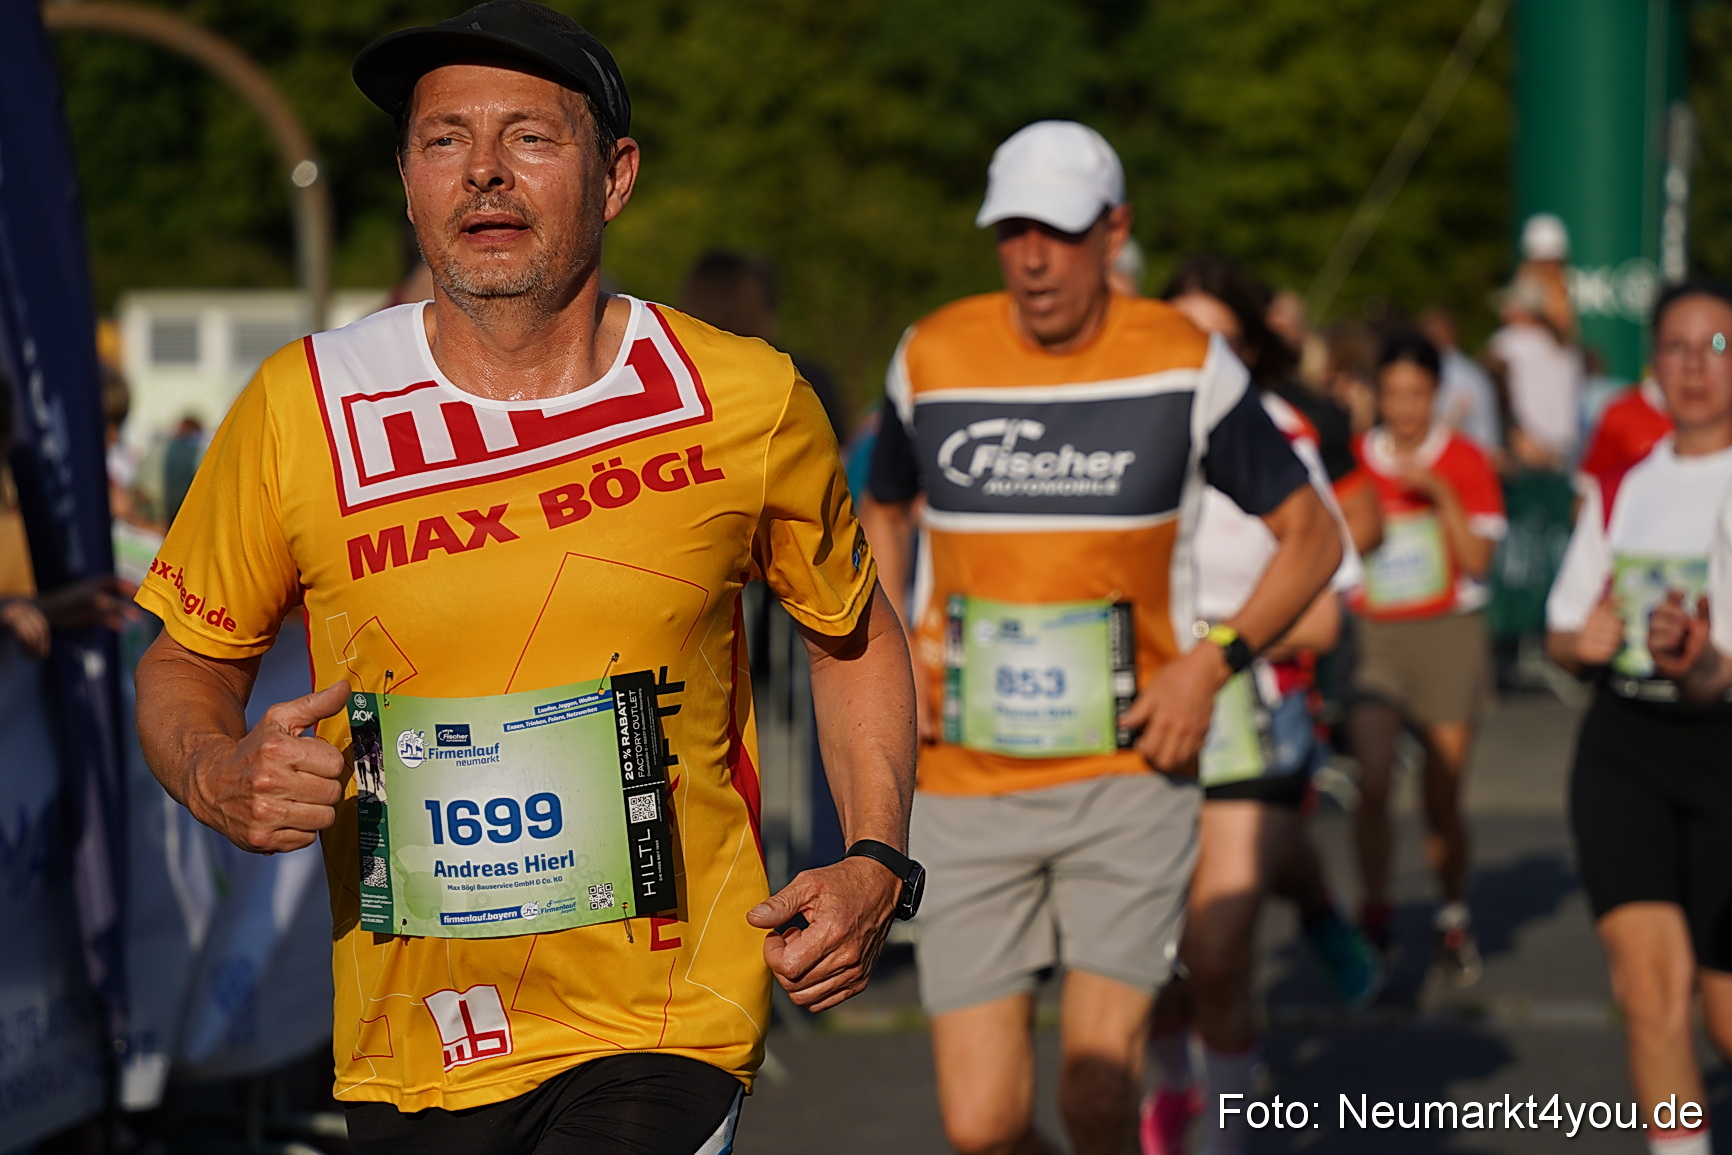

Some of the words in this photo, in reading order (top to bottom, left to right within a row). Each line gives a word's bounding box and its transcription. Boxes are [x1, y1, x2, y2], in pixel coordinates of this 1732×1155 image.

[968, 443, 1136, 480] Fischer
[346, 503, 520, 581] MAX
[538, 444, 725, 529] BÖGL
[352, 710, 375, 722] AOK
[616, 691, 631, 746] RABATT
[629, 690, 641, 730] OUTLET
[428, 742, 500, 759] Firmenlauf
[456, 755, 500, 766] neumarkt
[633, 731, 645, 778] FACTORY
[624, 762, 635, 780] 20
[425, 792, 564, 846] 1699
[433, 860, 519, 878] Andreas
[524, 849, 575, 873] Hierl
[638, 828, 657, 897] HILTL
[461, 884, 476, 892] Bögl
[476, 882, 514, 891] Bauservice
[514, 880, 535, 888] GmbH
[443, 909, 518, 924] firmenlauf.bayern
